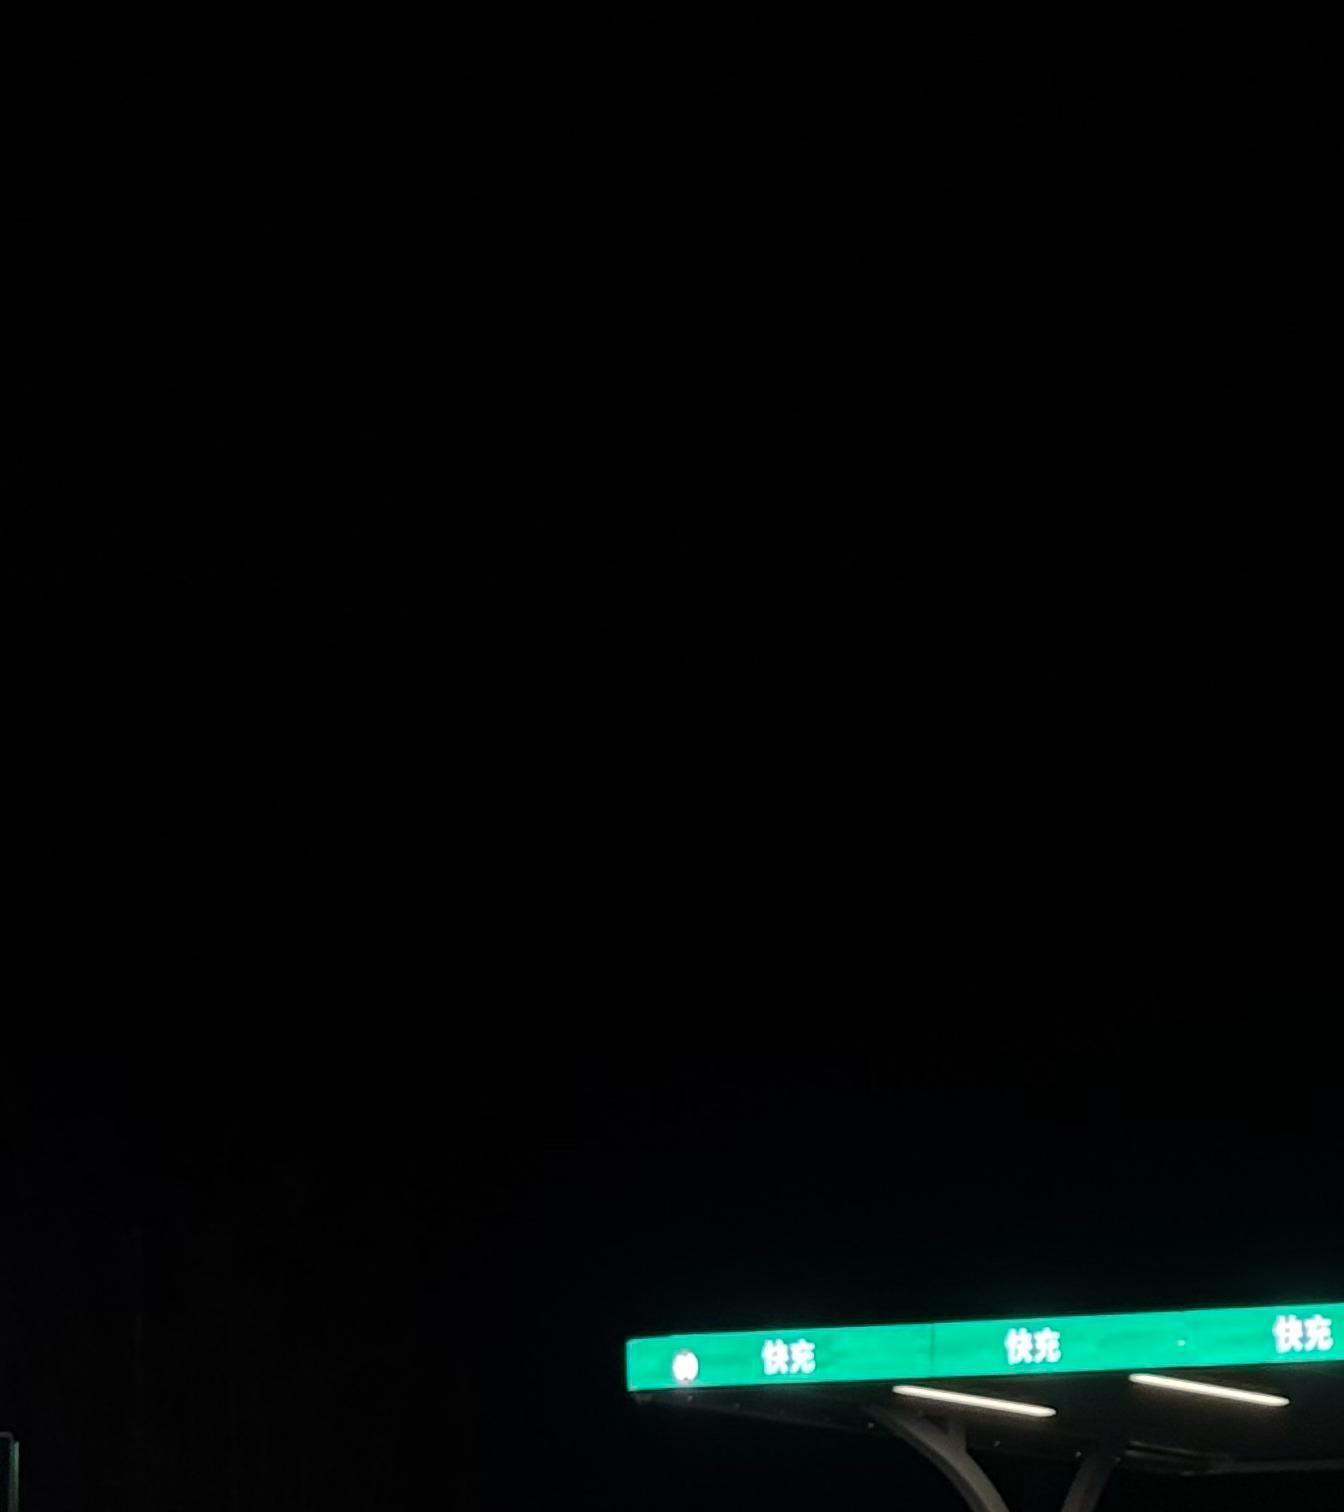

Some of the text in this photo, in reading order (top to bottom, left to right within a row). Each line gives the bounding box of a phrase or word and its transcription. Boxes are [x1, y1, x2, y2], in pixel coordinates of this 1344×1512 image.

[1005, 1328, 1060, 1363] 快充
[1273, 1315, 1333, 1352] 快充
[762, 1340, 815, 1374] 快充
